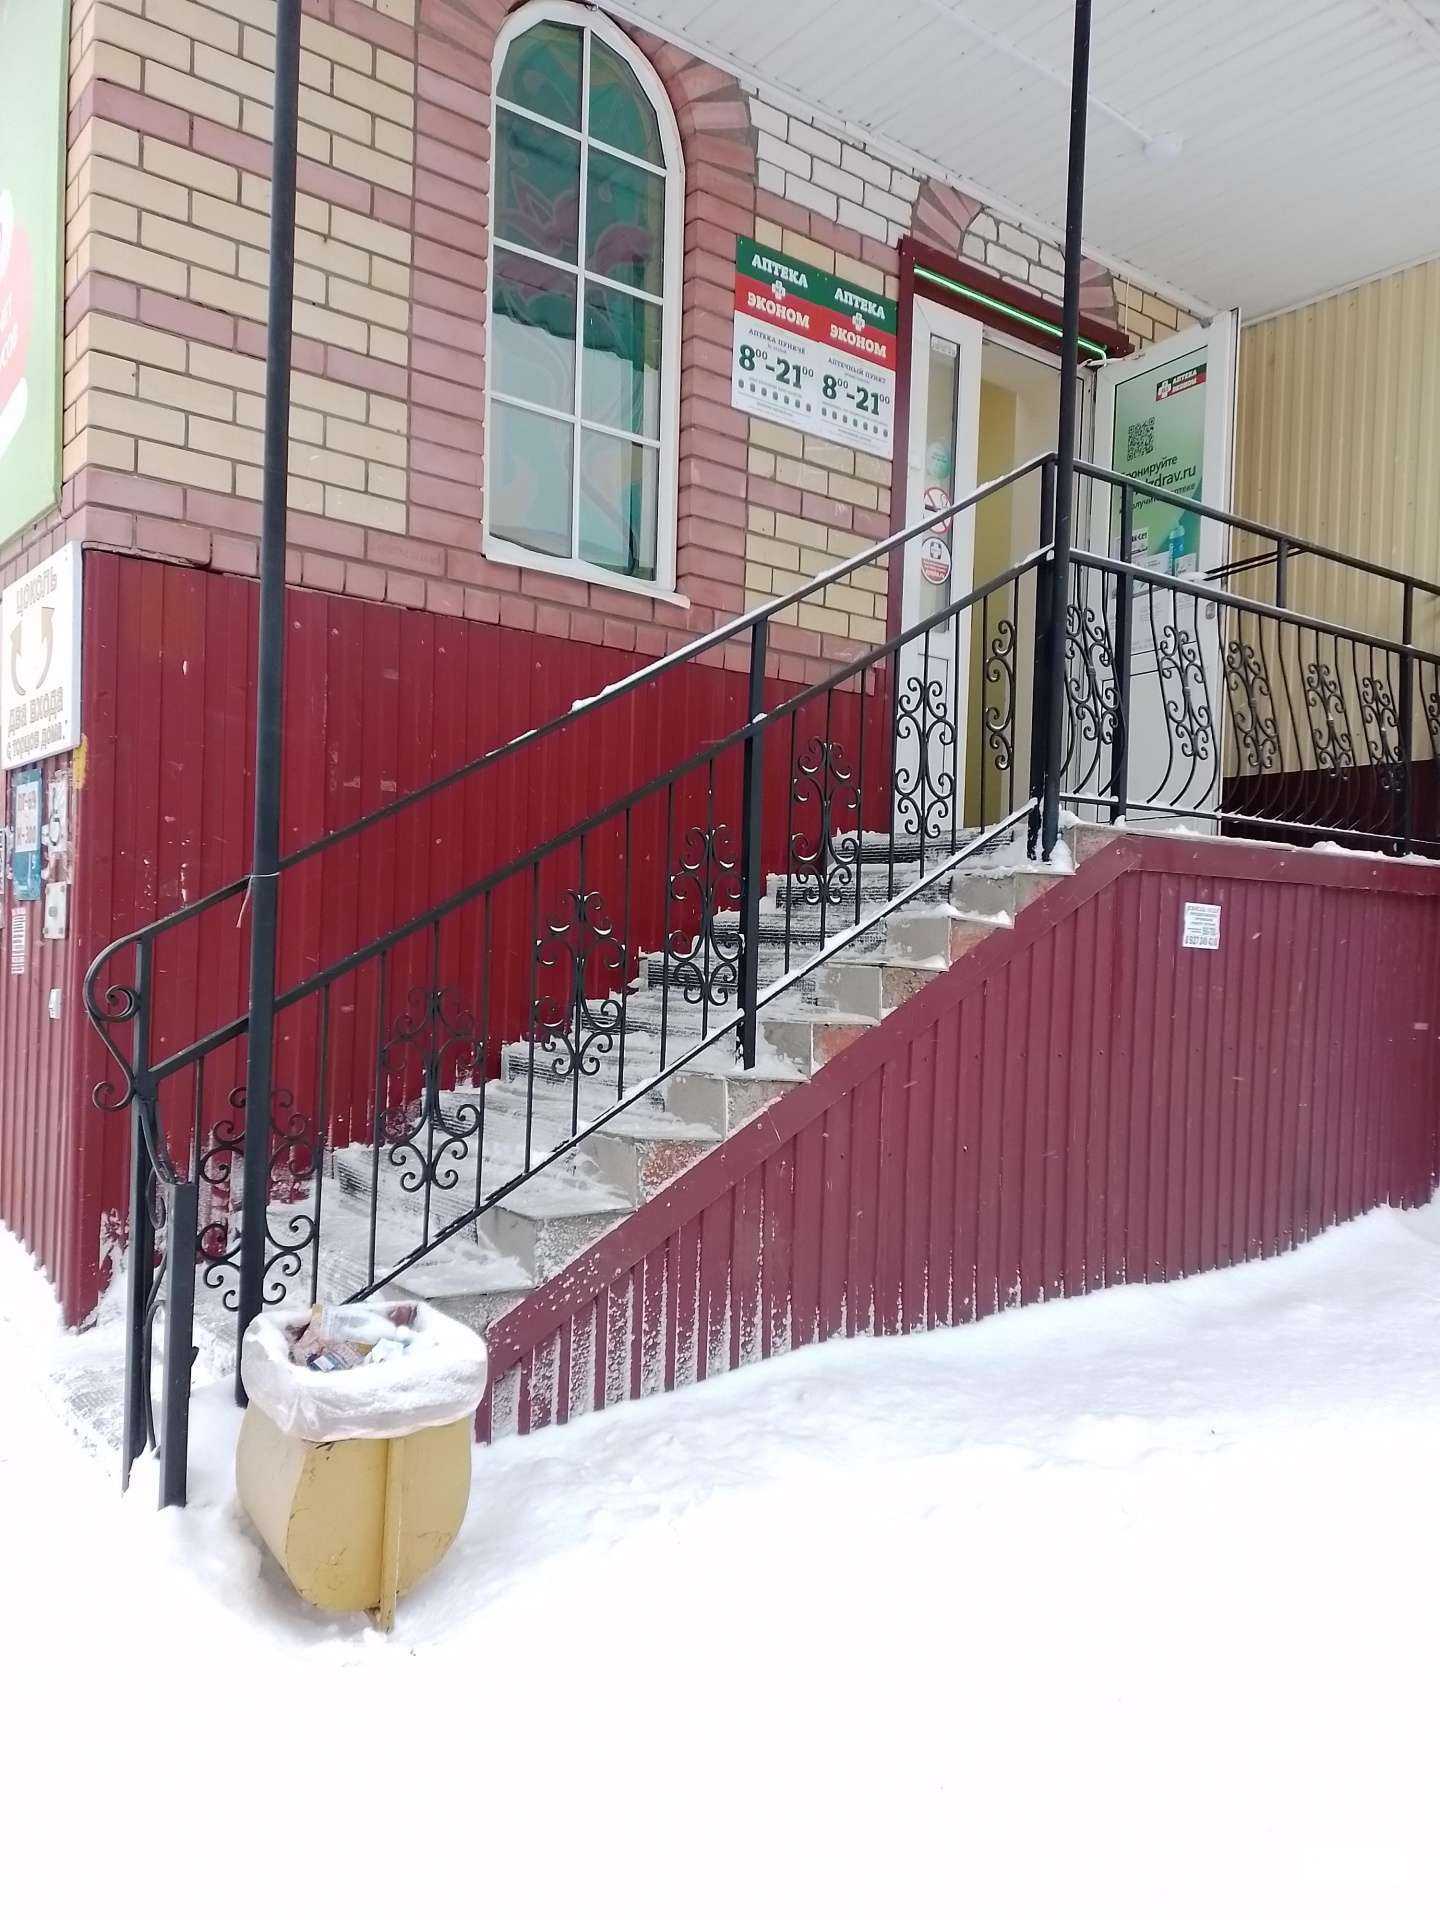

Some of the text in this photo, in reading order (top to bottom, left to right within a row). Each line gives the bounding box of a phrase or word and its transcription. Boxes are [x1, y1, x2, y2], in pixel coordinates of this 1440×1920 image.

[752, 254, 808, 288] АПТЕКА
[748, 292, 809, 328] ЭКОНОМ
[834, 287, 886, 320] АПТЕКА
[829, 323, 887, 358] ЭКОНОМ
[1121, 456, 1177, 478] онируйте
